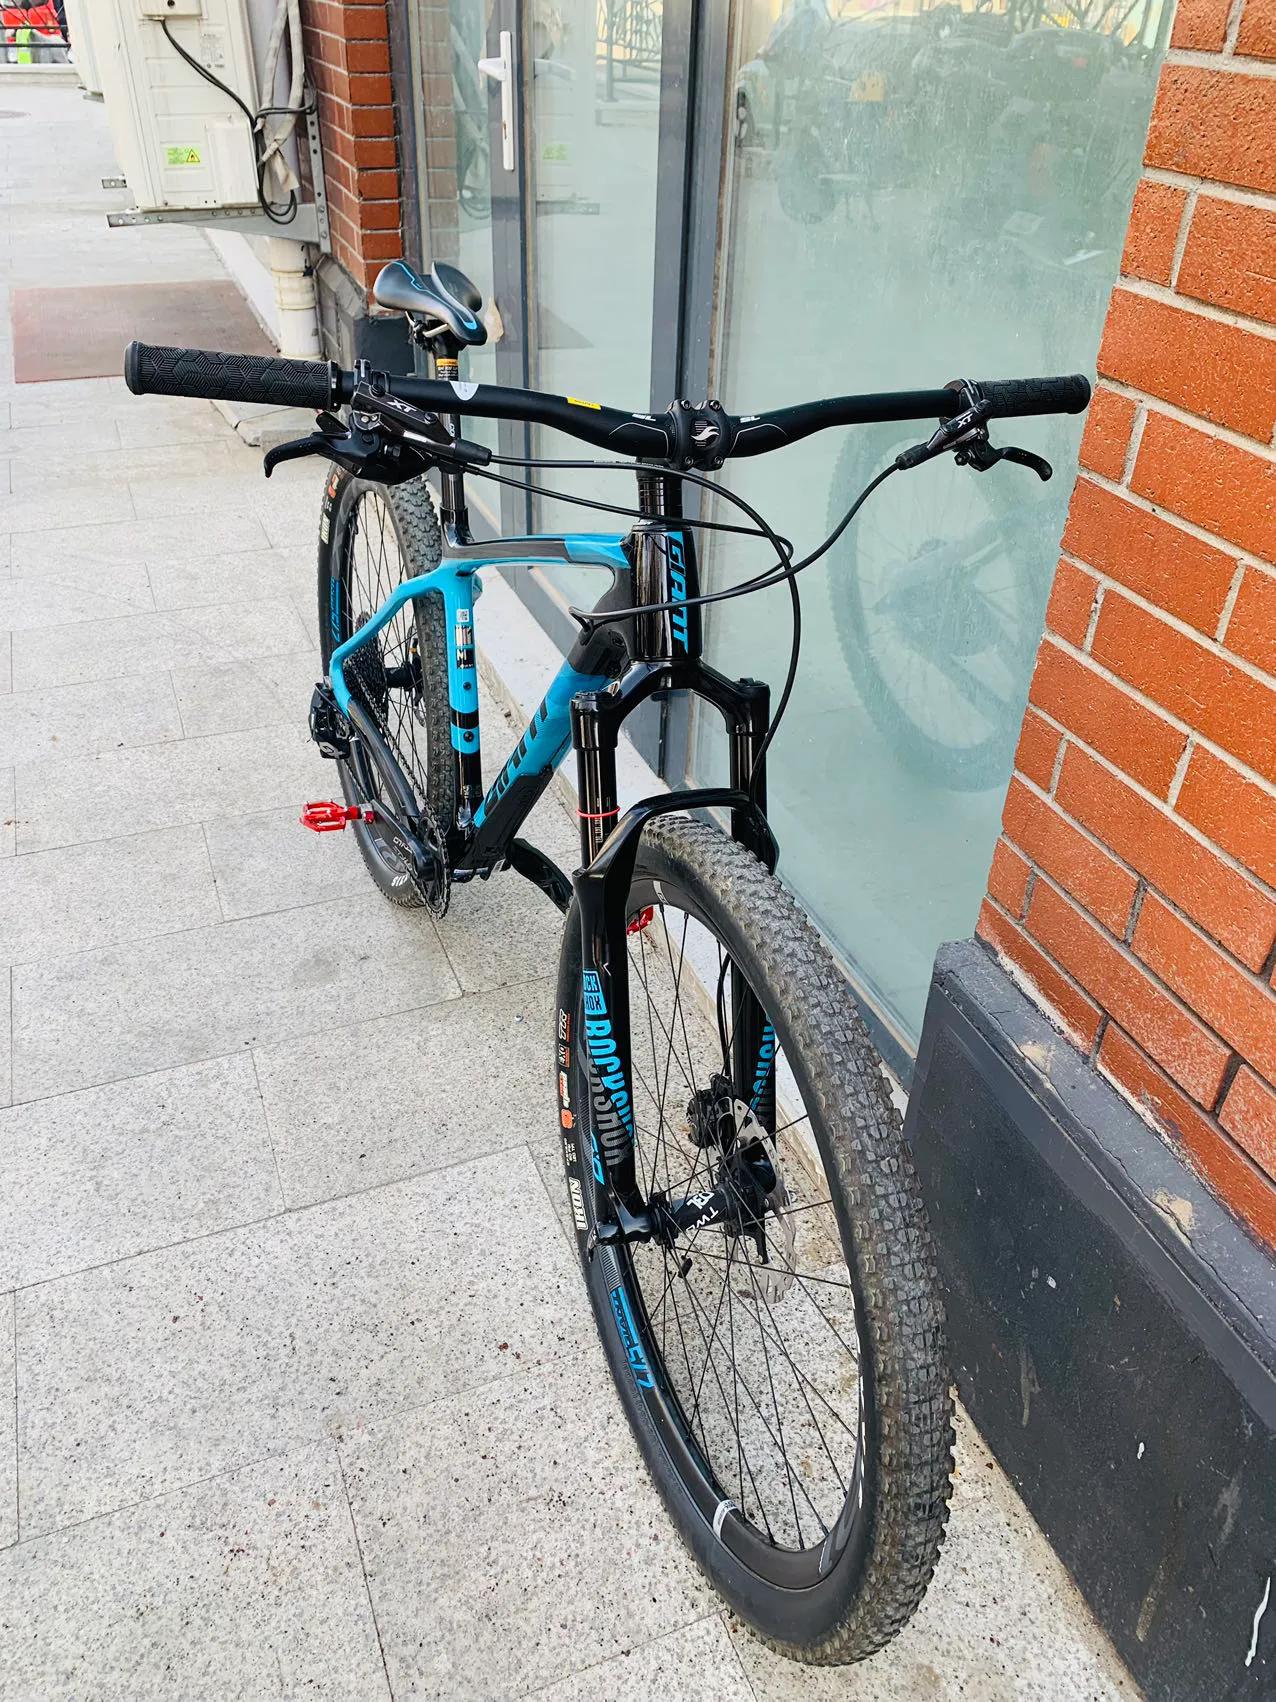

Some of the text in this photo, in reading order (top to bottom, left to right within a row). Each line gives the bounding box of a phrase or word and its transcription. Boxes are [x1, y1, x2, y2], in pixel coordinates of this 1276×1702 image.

[386, 399, 417, 413] XT
[957, 413, 973, 428] XT
[667, 535, 688, 654] GIANT
[569, 1177, 588, 1230] IKON
